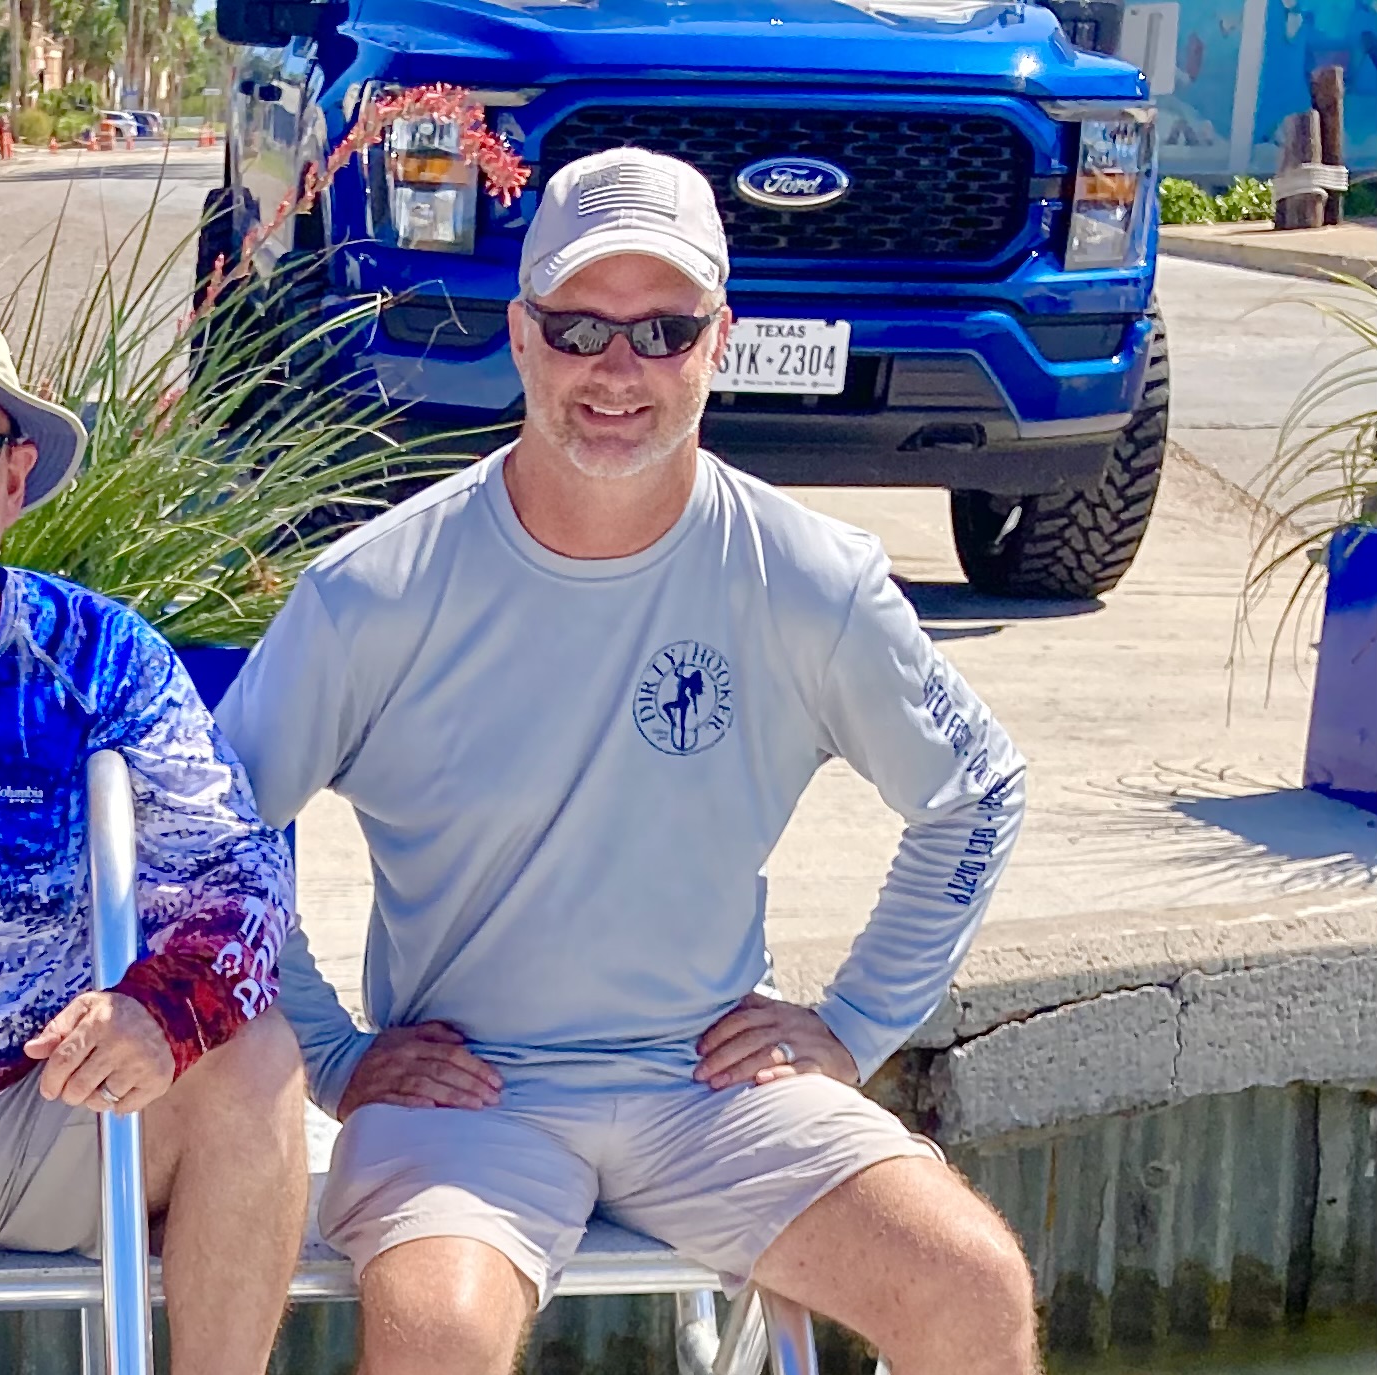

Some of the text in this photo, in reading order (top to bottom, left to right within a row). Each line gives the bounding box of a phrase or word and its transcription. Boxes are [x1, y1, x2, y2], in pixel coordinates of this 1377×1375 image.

[763, 167, 824, 194] Ford
[755, 323, 807, 339] TEXAS
[964, 822, 998, 856] GET
[942, 859, 987, 906] DIRTY
